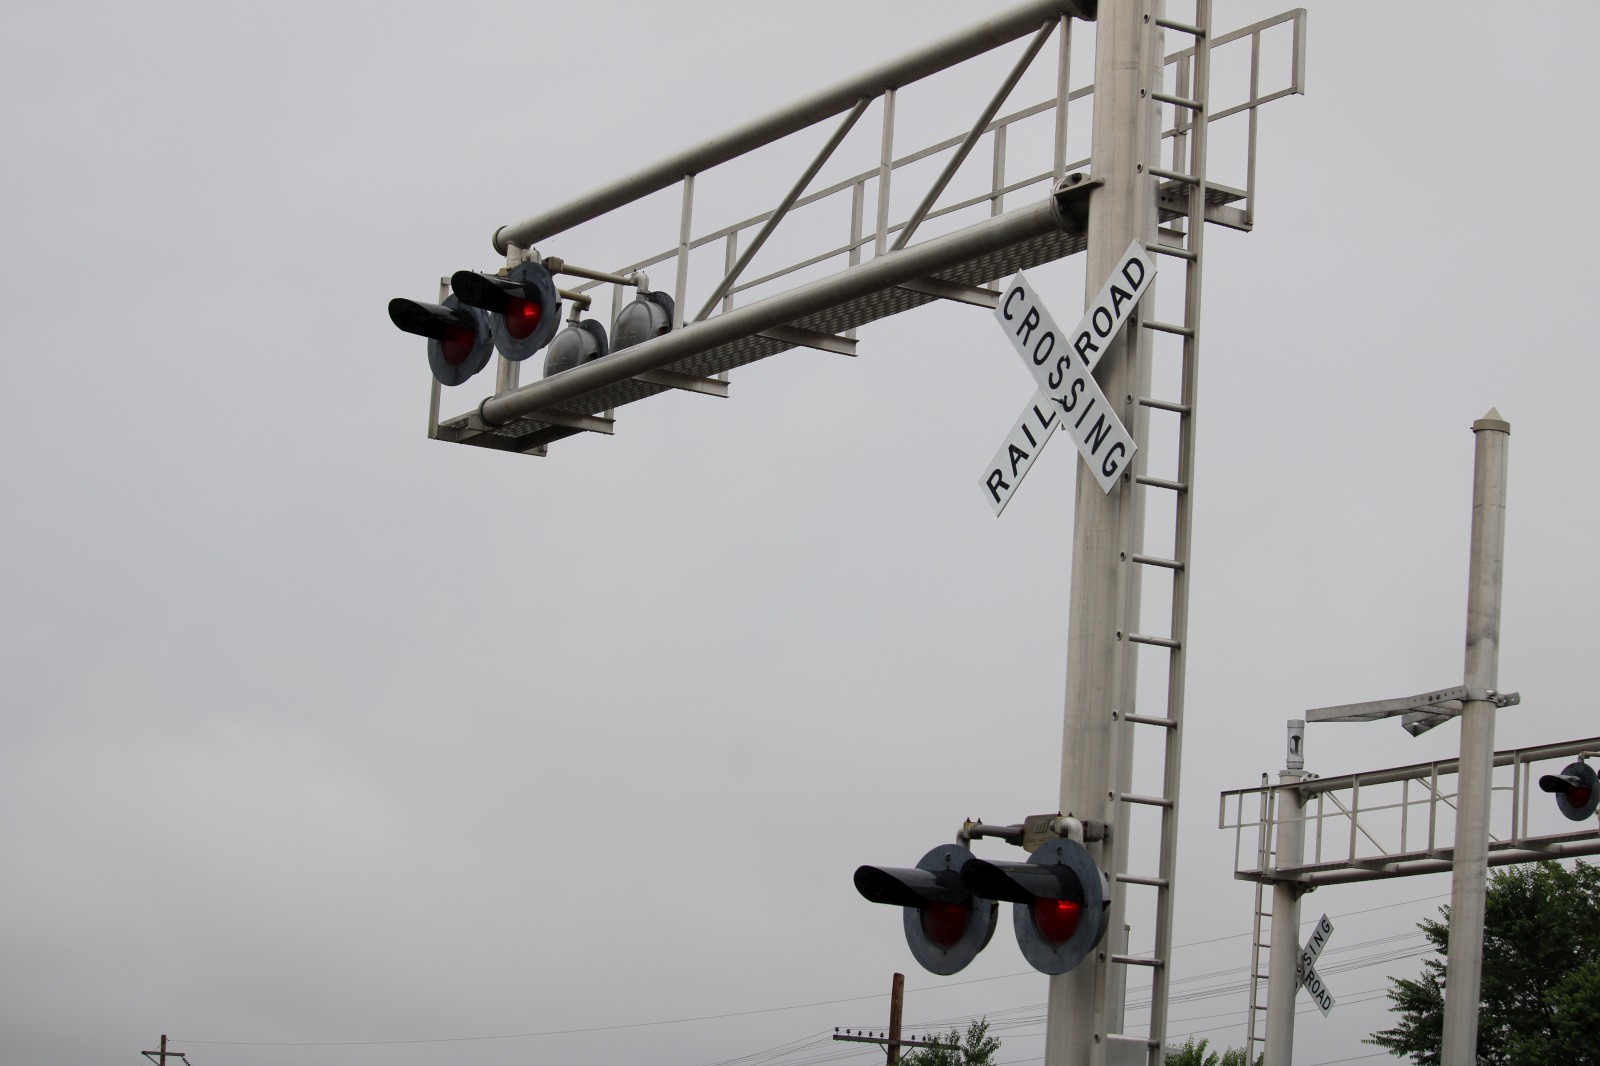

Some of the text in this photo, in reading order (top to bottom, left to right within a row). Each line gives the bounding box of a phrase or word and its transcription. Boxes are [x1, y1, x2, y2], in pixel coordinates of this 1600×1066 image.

[986, 257, 1146, 504] RAIL ROAD
[1003, 286, 1126, 478] CROSSING
